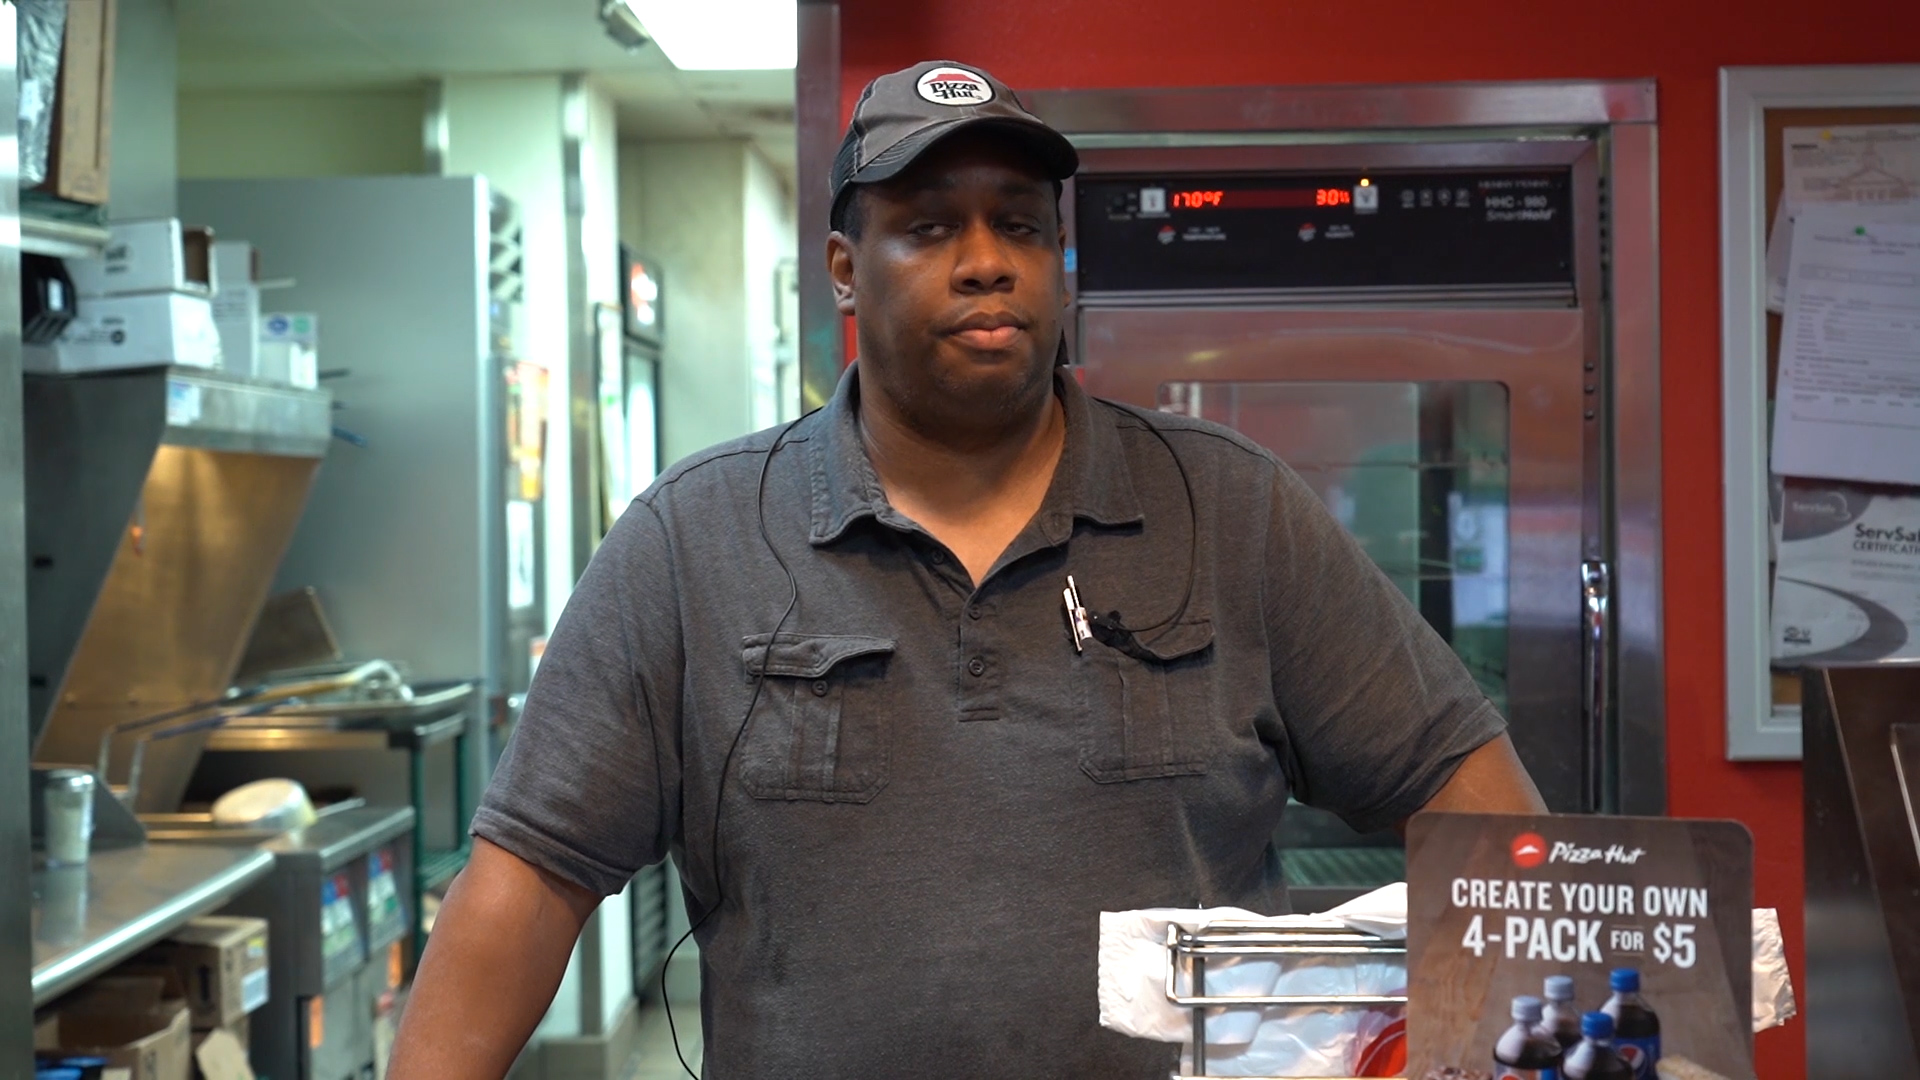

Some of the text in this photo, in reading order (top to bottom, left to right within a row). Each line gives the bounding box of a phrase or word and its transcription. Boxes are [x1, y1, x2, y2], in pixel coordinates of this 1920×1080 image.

[930, 81, 980, 93] Pizza
[935, 88, 976, 100] Hut
[1853, 540, 1920, 555] CERTIFICATI
[1549, 841, 1647, 865] Pizza Hut
[1451, 878, 1708, 918] CREATE YOUR OWN
[1461, 915, 1697, 969] 4-PACK FOR $5
